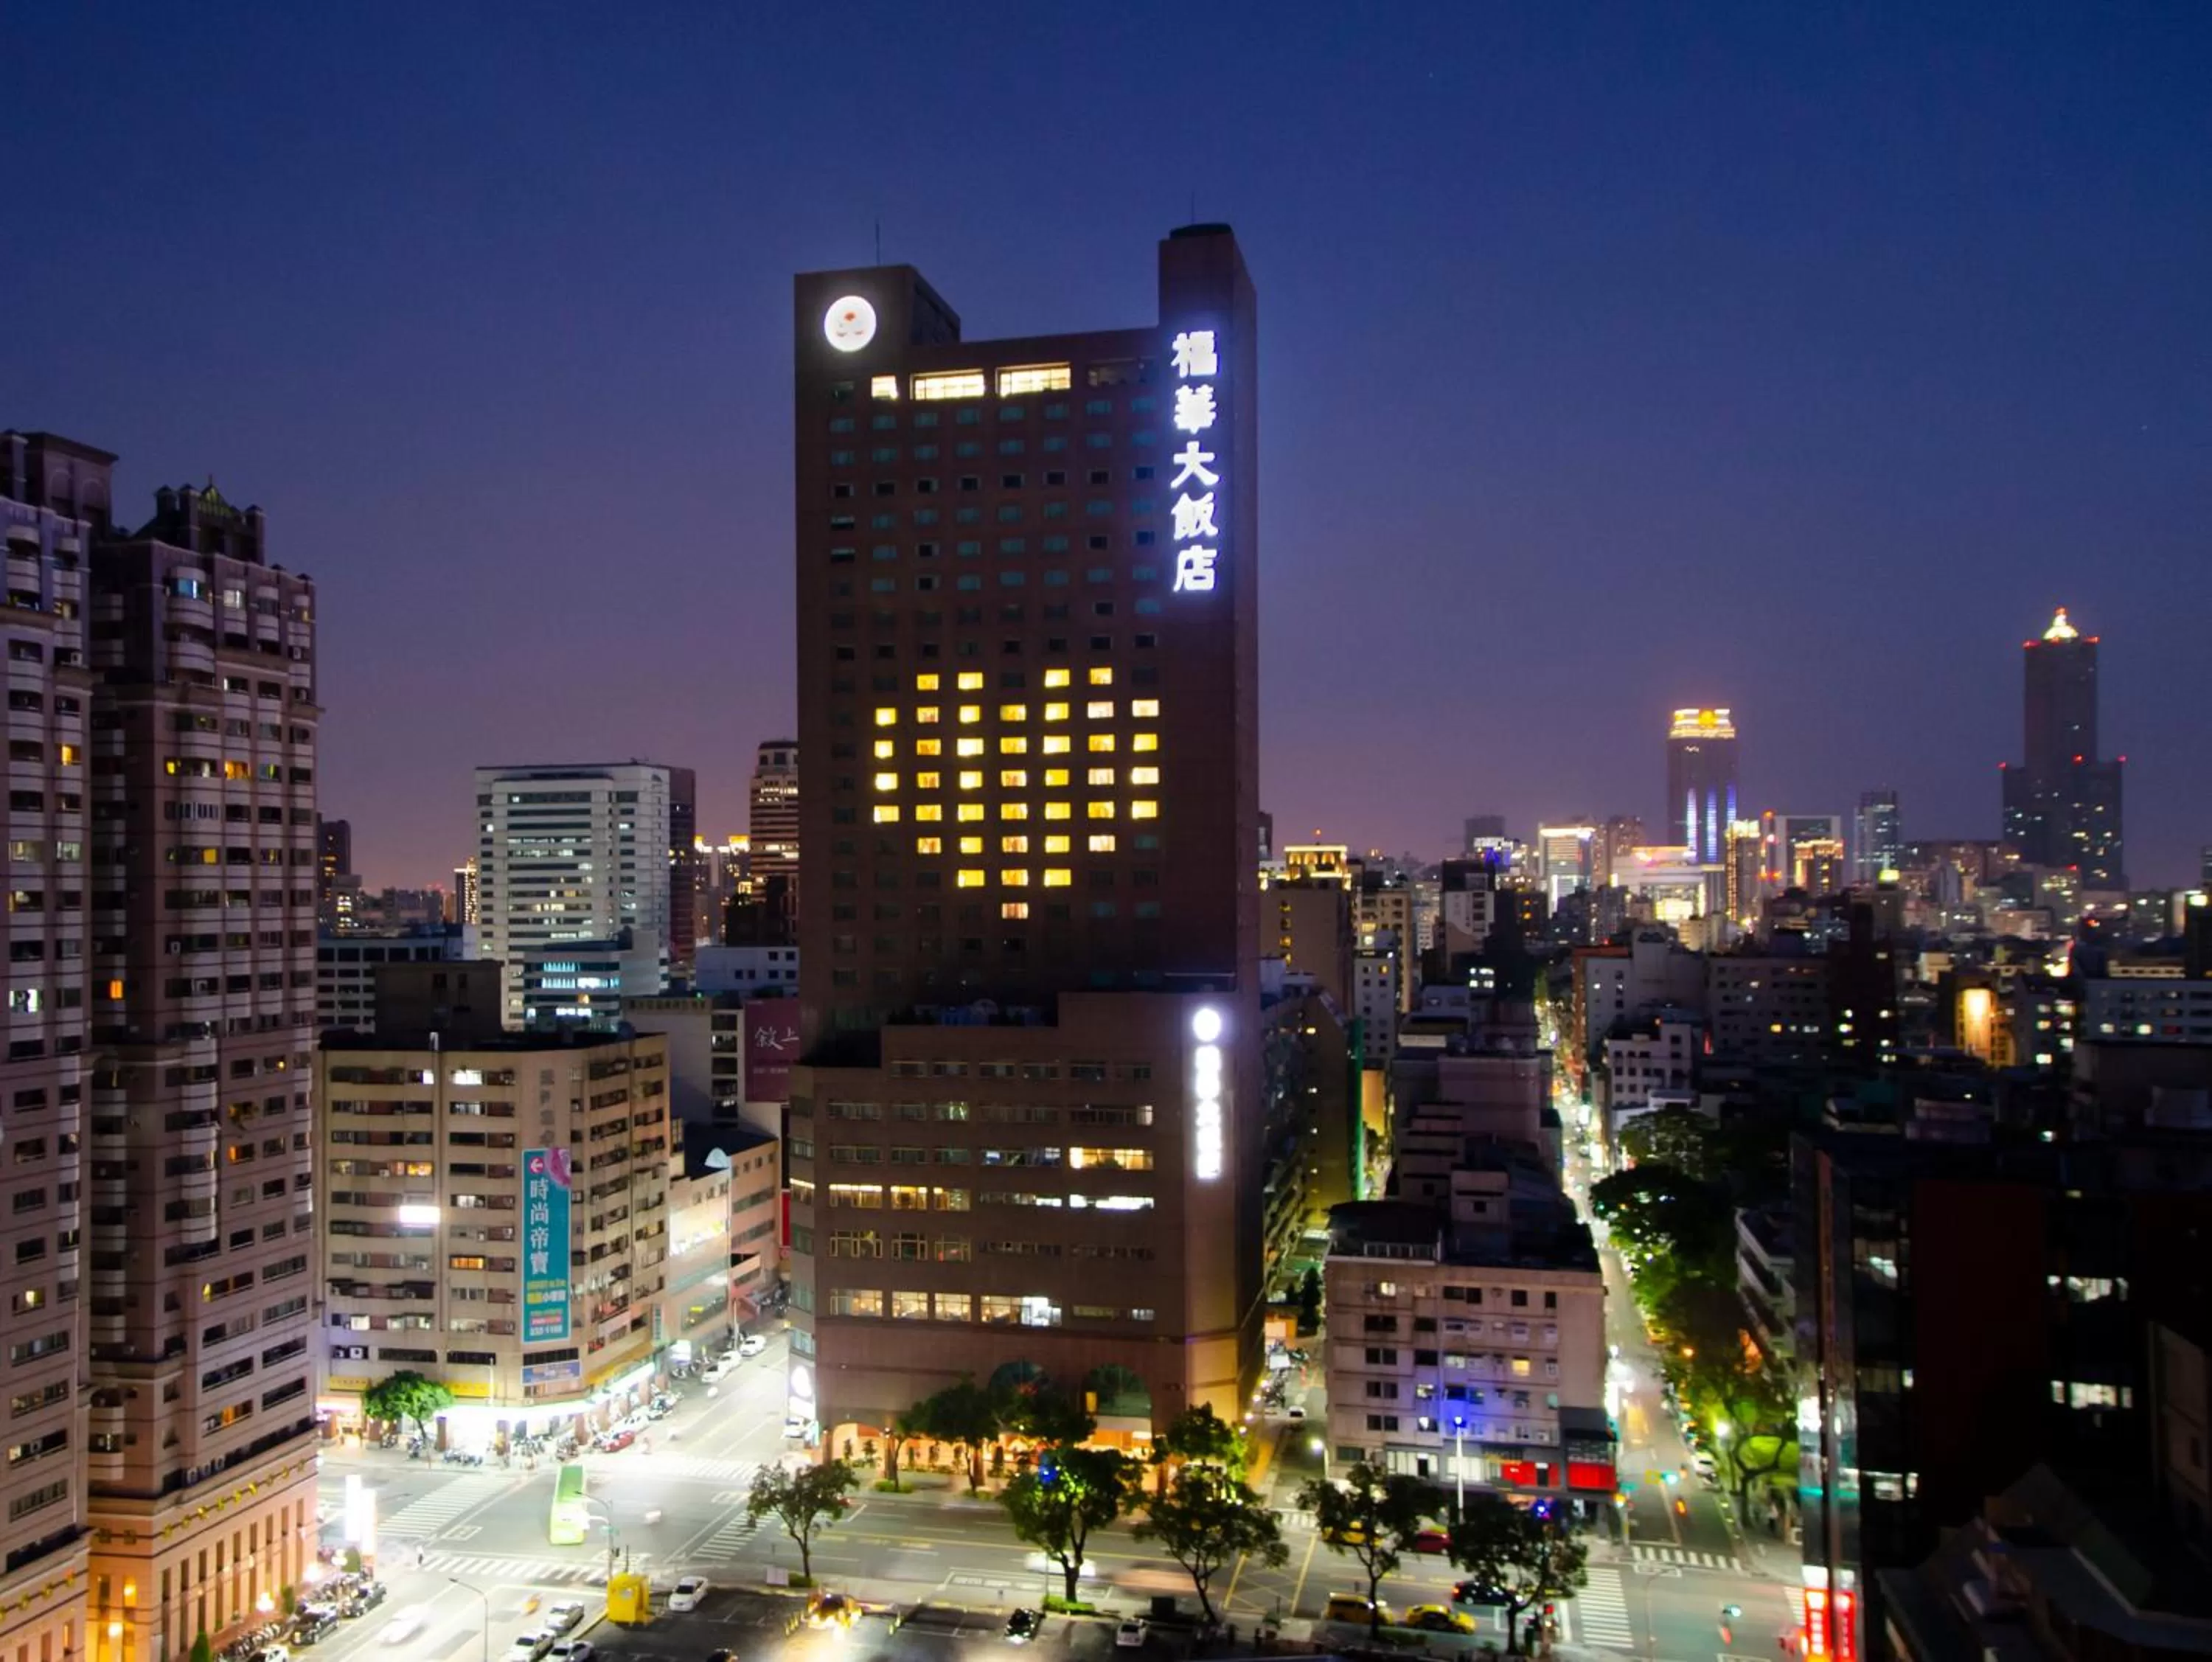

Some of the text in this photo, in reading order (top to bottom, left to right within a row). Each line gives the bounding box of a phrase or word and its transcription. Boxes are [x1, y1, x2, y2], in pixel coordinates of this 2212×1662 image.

[1170, 331, 1219, 592] 福華大飯店
